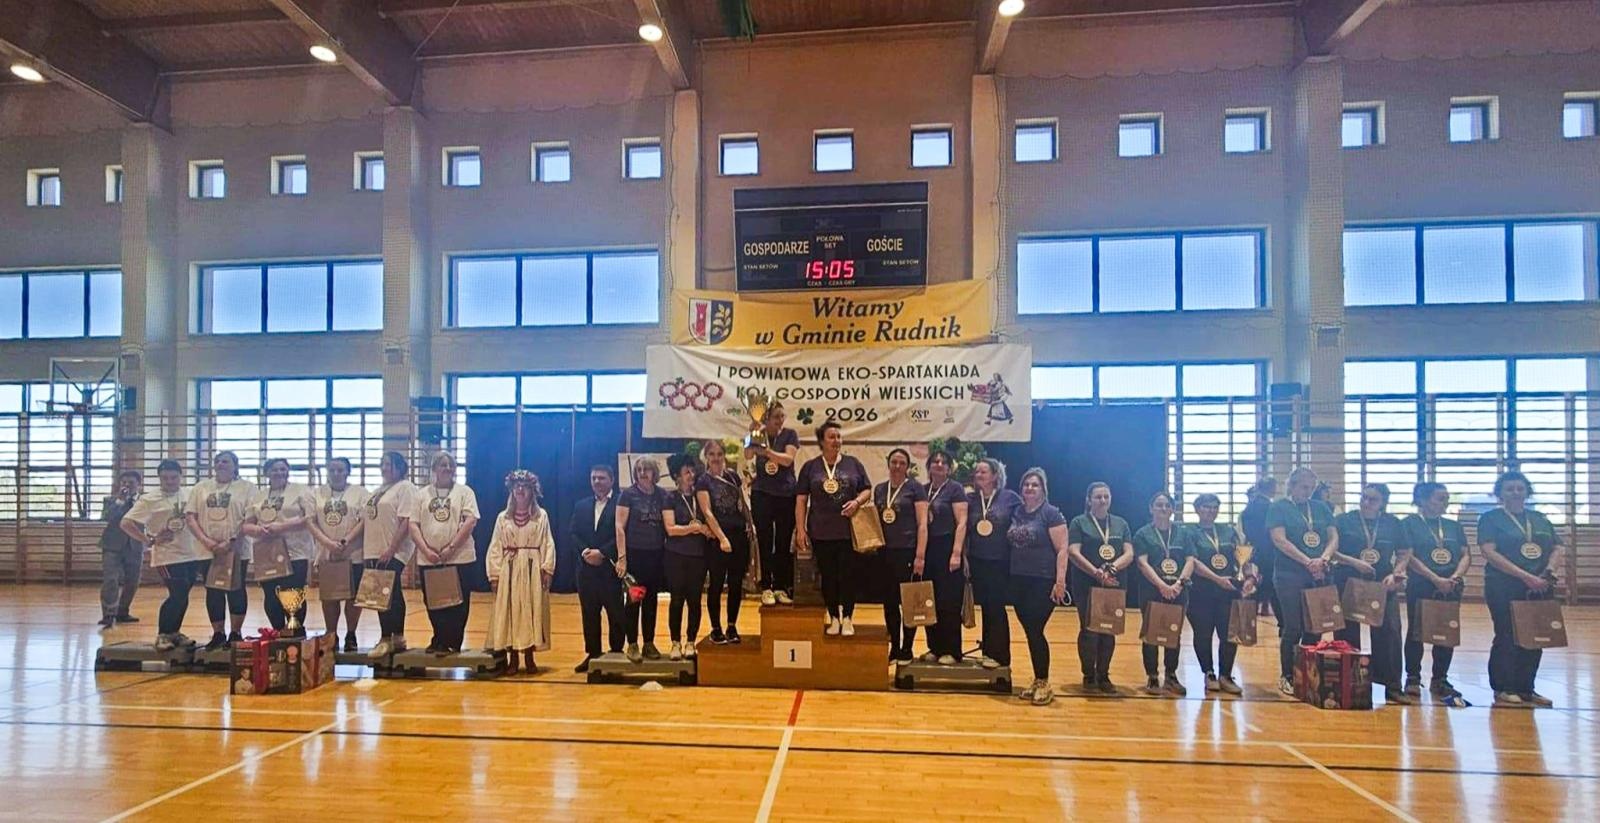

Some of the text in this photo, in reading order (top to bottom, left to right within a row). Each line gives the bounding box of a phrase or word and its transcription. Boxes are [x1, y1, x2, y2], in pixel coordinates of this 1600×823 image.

[744, 241, 809, 256] GOSPODARZE
[867, 235, 904, 252] GOŚCIE
[806, 260, 854, 279] 15:05
[812, 297, 904, 319] Witamy
[755, 316, 961, 345] w Gminie Rudnik
[717, 364, 981, 381] I POWIATOWA EKO-SPARTAKIADA
[776, 384, 871, 401] GOSPODYŃ
[879, 385, 964, 401] WIEJSKICH
[825, 407, 878, 422] 2026
[789, 648, 796, 663] 1
